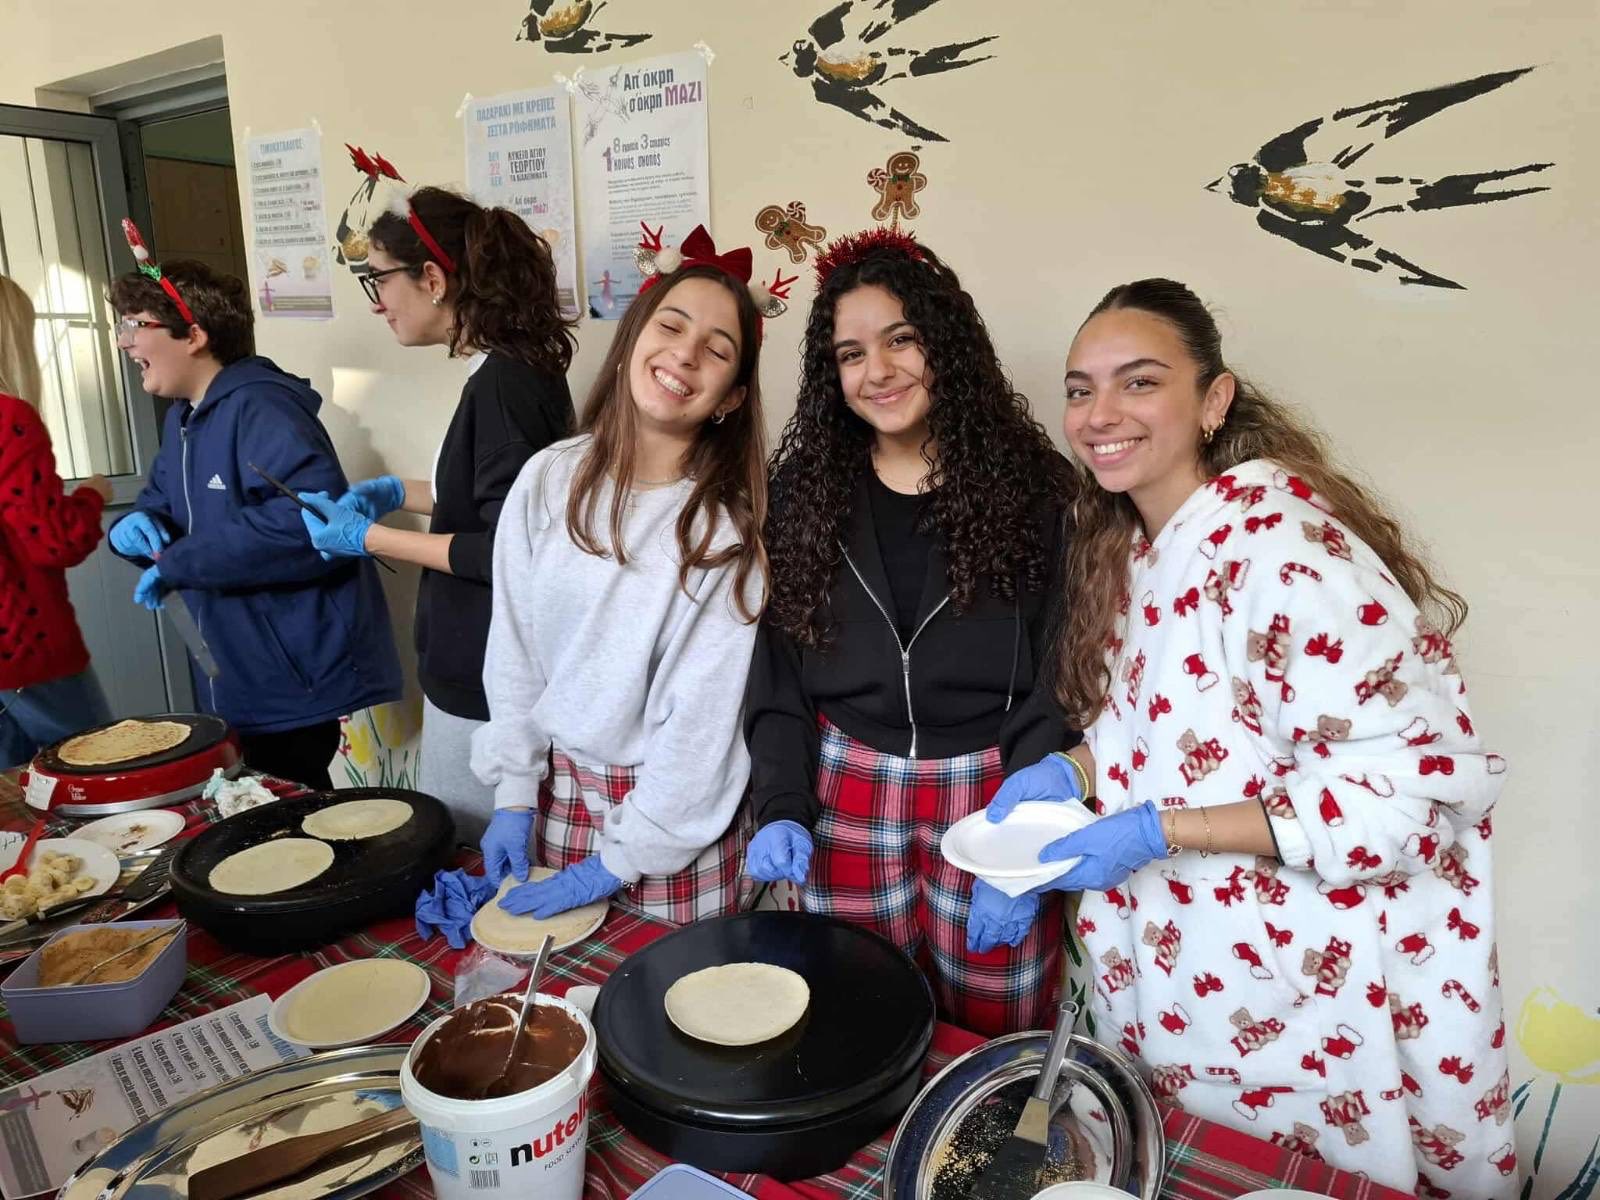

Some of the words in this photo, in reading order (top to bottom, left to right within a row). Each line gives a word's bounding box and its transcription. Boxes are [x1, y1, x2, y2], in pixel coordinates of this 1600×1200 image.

[665, 80, 702, 106] ΜΑΖΙ
[613, 137, 621, 153] 8
[510, 157, 545, 174] ΓΕΩΡΓΙΟΥ
[510, 1089, 588, 1167] nutell
